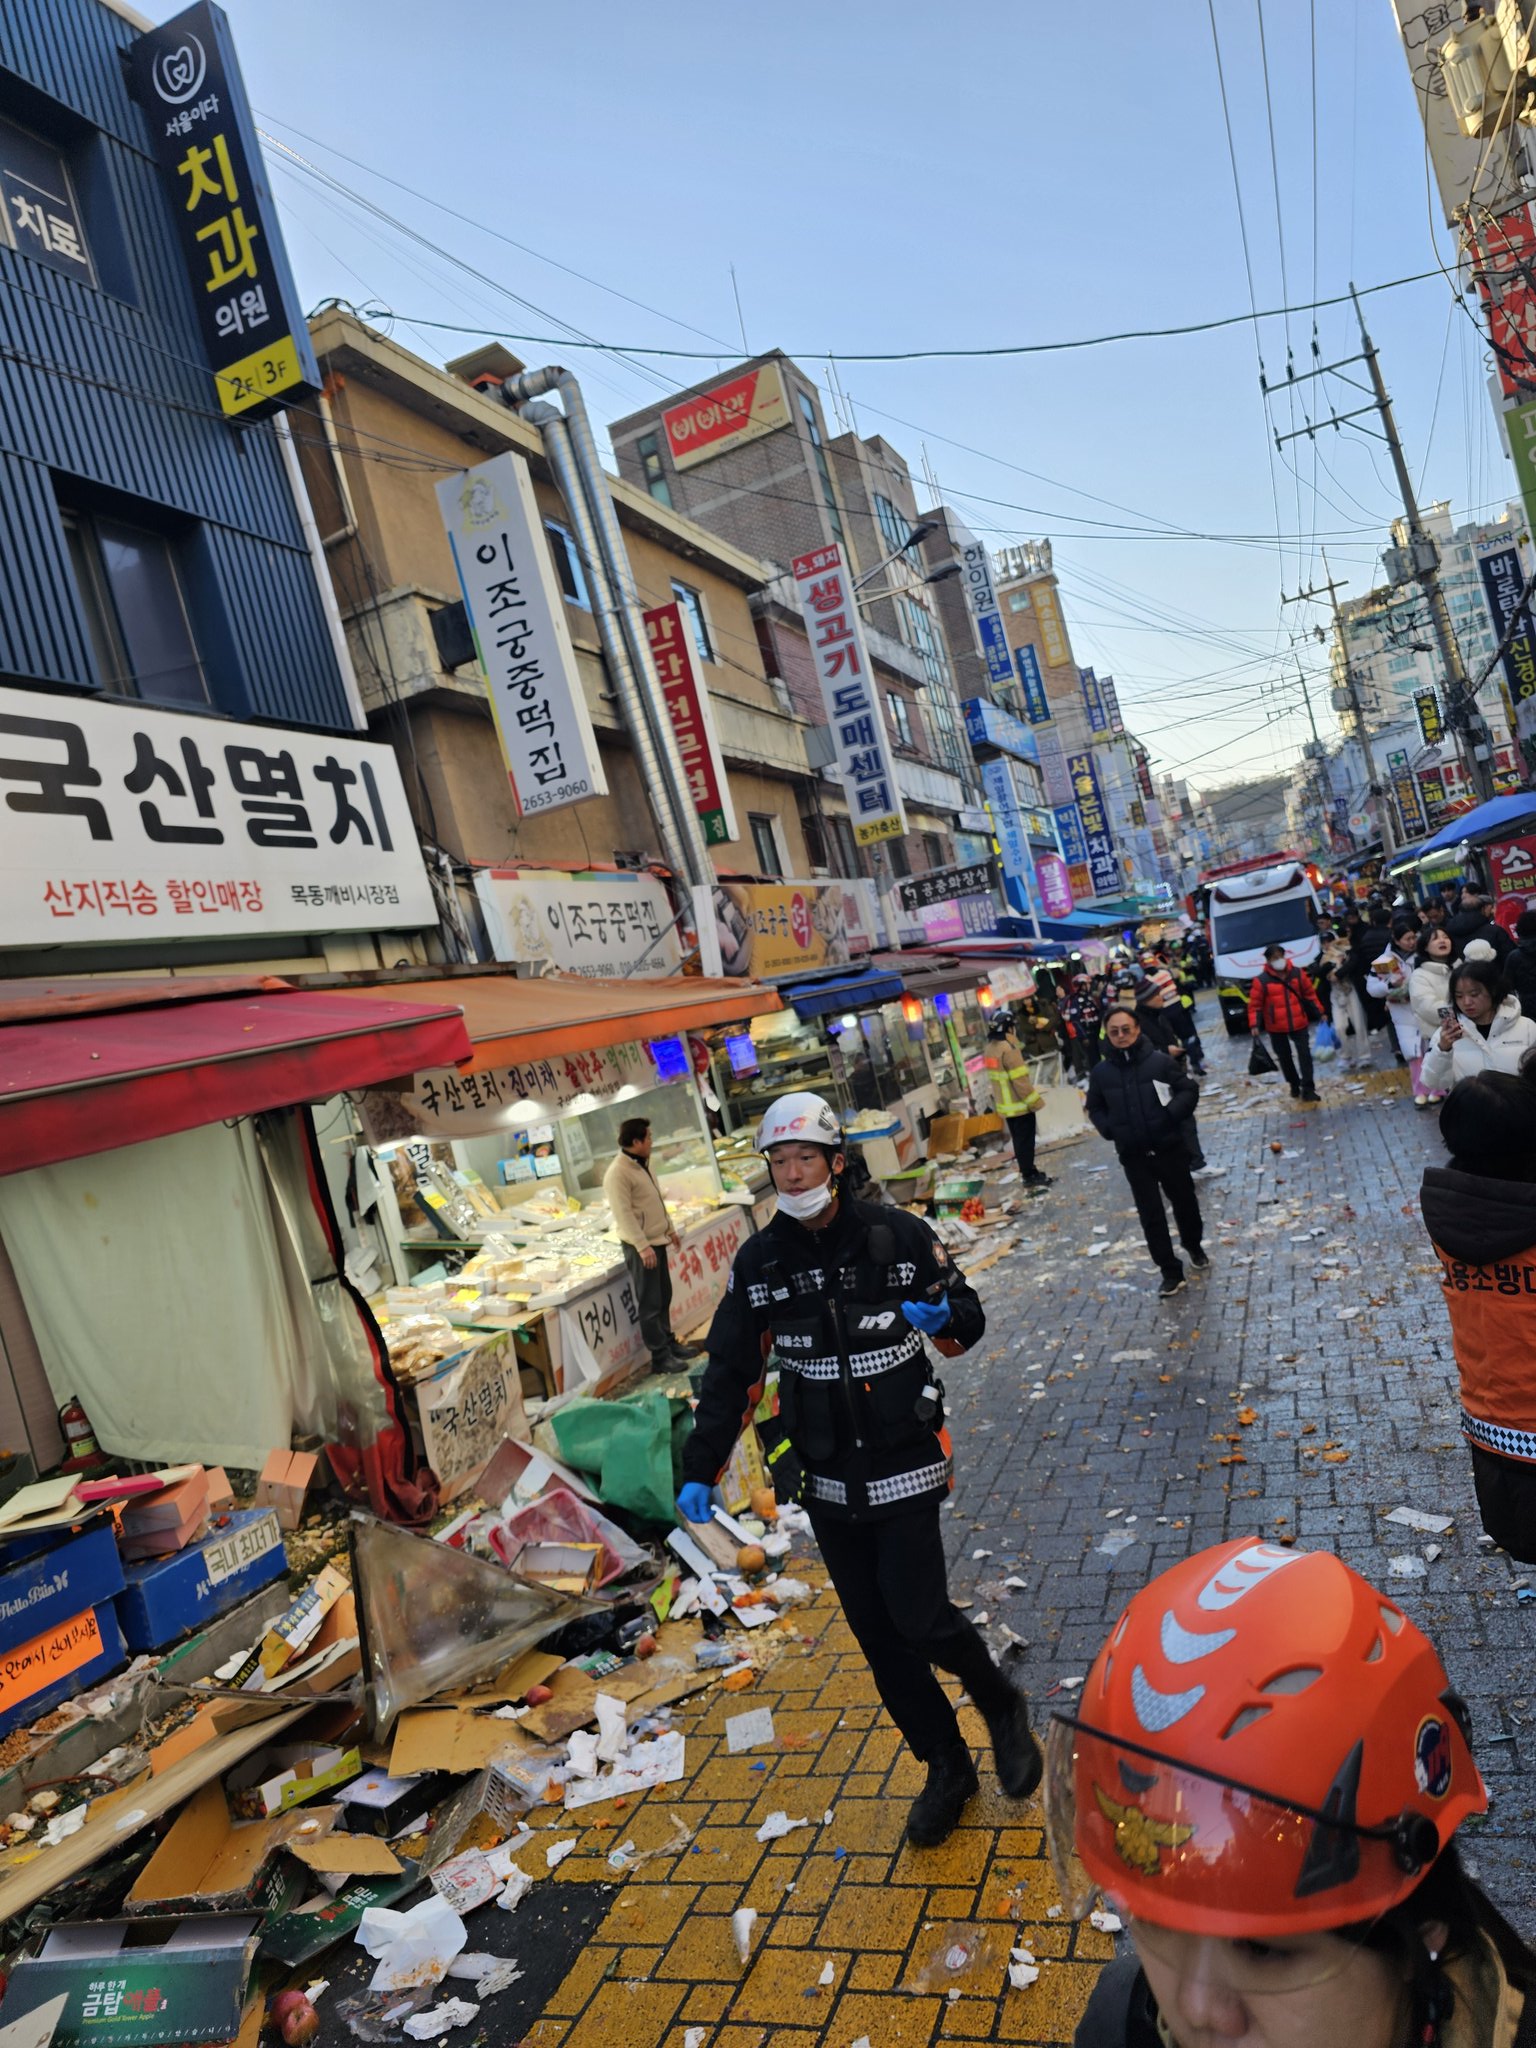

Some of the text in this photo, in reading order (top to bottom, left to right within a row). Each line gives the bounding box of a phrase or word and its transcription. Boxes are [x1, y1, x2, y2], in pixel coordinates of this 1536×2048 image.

[165, 94, 219, 137] 서울이다
[11, 195, 87, 265] 치료
[176, 133, 259, 293] 치과
[214, 285, 270, 338] 의원
[229, 360, 288, 401] 2F 3F
[672, 391, 748, 441] 비비안
[964, 545, 994, 612] 한의원
[807, 575, 860, 678] 생고기
[476, 533, 567, 787] 이조궁중떡집
[831, 681, 895, 816] 도매센터
[0, 713, 395, 852] 국산멸치
[522, 779, 589, 812] 2653-9060
[1072, 756, 1104, 834] 서울온빛
[1089, 836, 1114, 873] 치과
[1501, 846, 1535, 875] 소
[43, 879, 264, 918] 산지직송 할인매장
[290, 883, 400, 908] 목동깨비시장점
[922, 867, 989, 897] 공중화장실
[547, 900, 660, 948] 이조궁중떡집
[774, 1332, 814, 1351] 서울소방
[857, 1310, 897, 1331] 119
[206, 1520, 280, 1577] 국내 최저가
